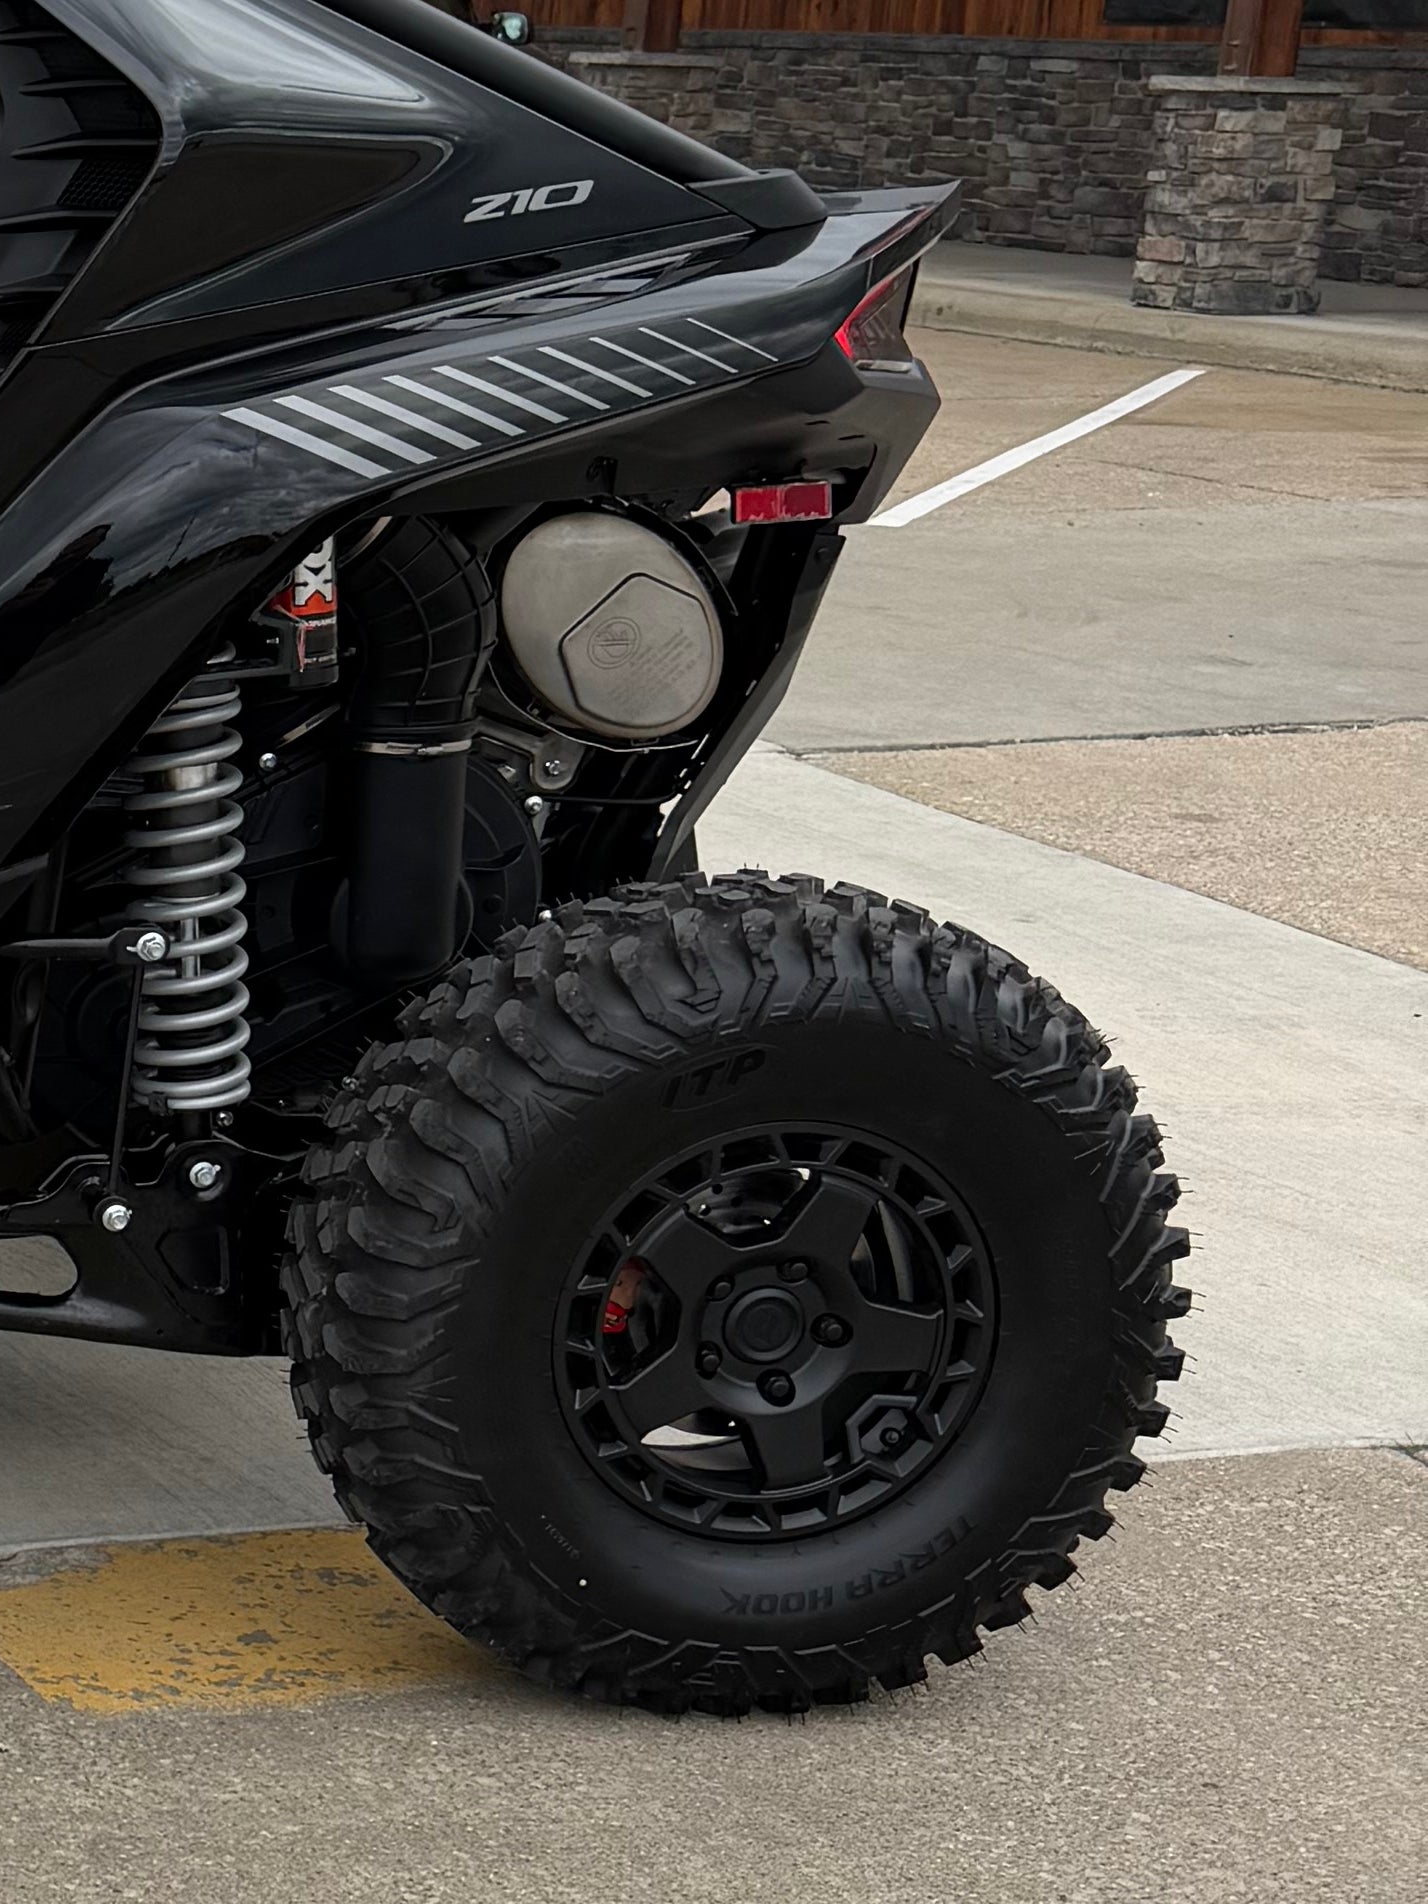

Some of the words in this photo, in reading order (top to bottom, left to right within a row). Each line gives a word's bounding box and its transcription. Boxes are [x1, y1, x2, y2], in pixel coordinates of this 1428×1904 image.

[463, 179, 594, 223] Z10
[661, 1048, 766, 1107] ITP
[845, 1516, 978, 1602] TERRA
[718, 1585, 834, 1618] HOOK
